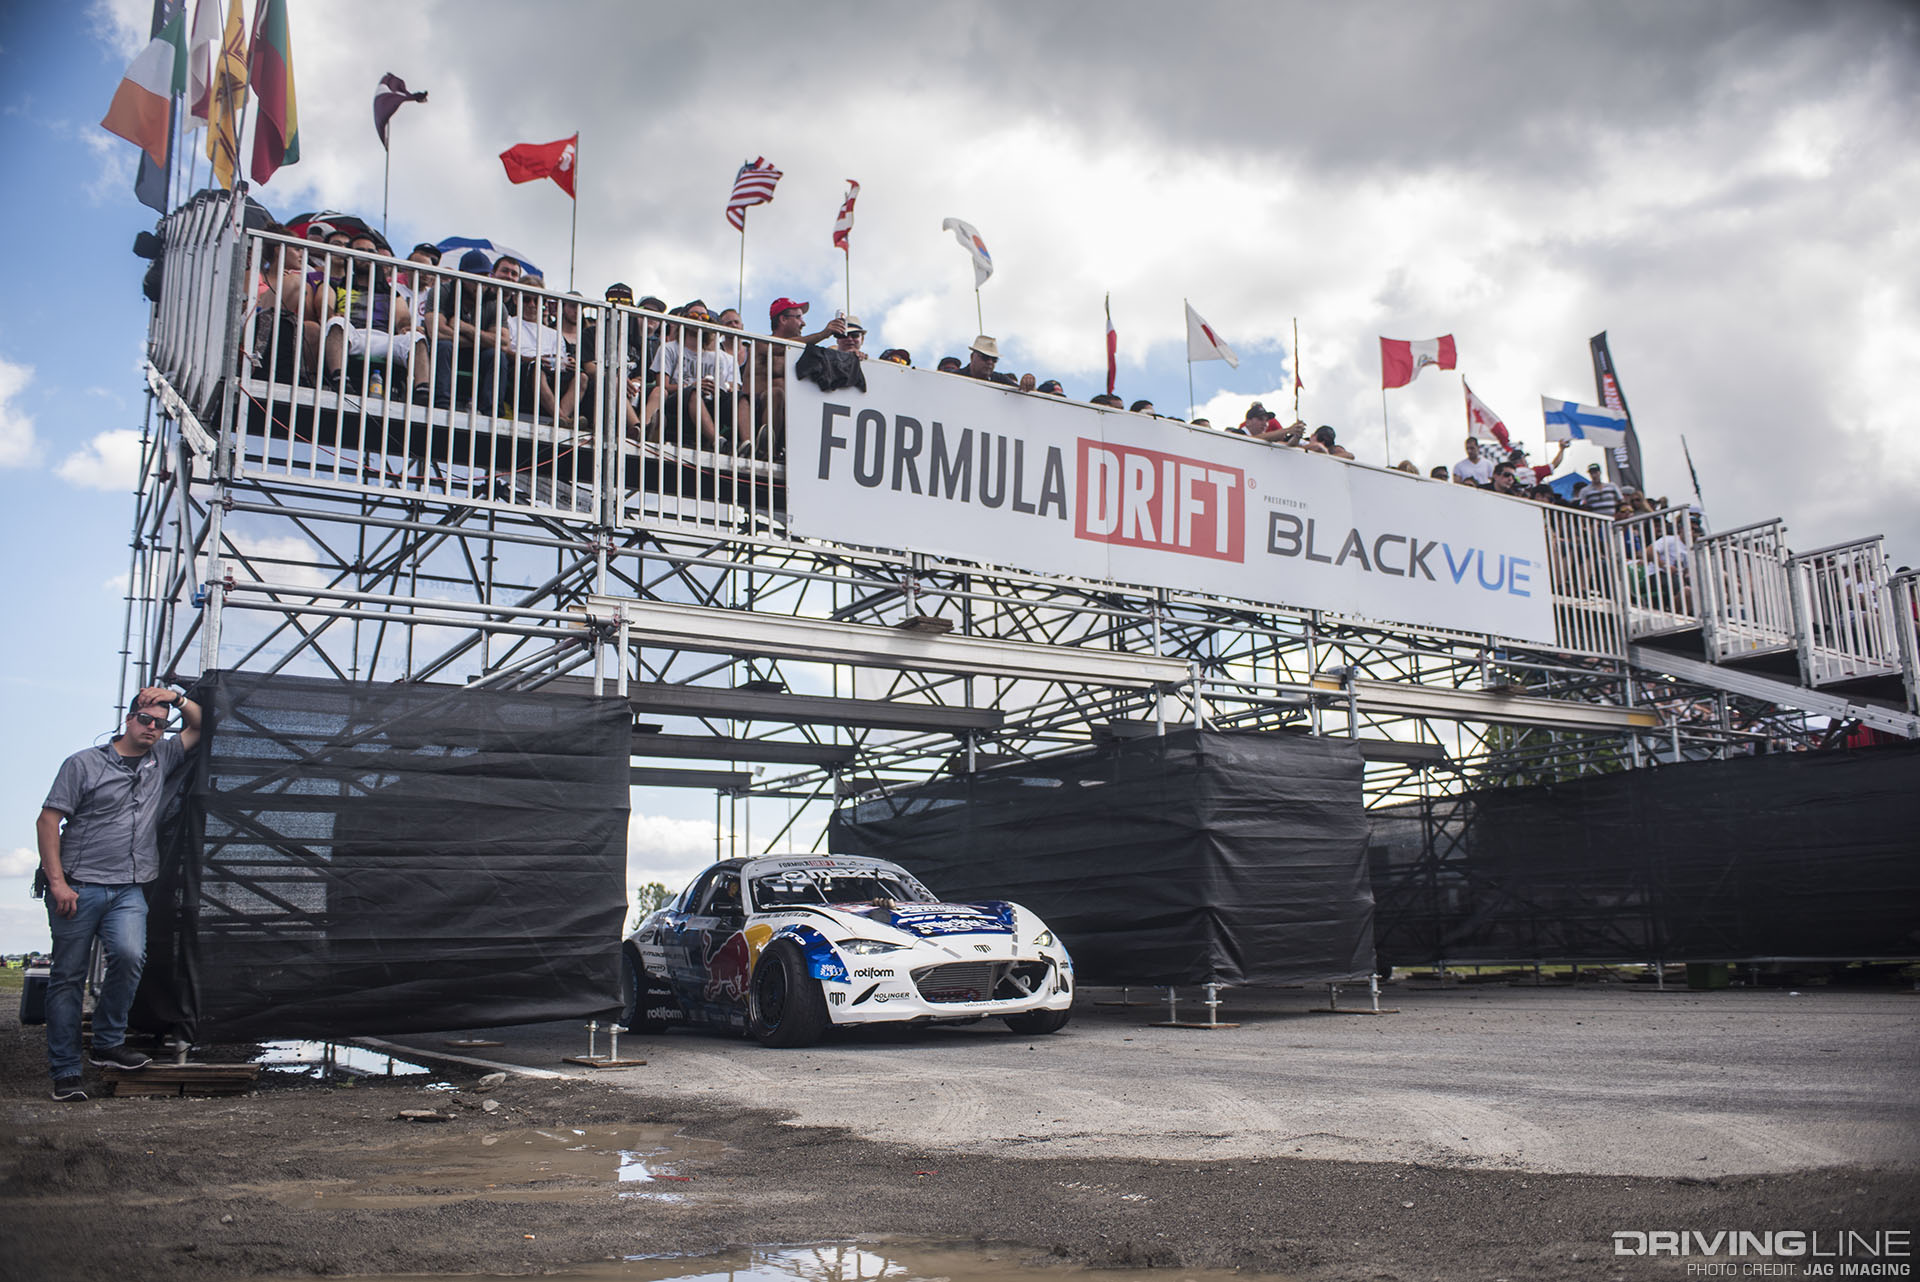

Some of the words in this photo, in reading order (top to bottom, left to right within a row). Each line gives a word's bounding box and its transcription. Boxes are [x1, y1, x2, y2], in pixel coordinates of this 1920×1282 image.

[818, 402, 1068, 521] FORMULA
[1086, 447, 1237, 555] DRIFT
[1263, 495, 1297, 508] PRESENTED
[1267, 511, 1531, 598] BLACKVUE
[854, 967, 894, 979] rotiform
[874, 991, 910, 999] HOLINGER
[647, 1006, 684, 1020] rotiform
